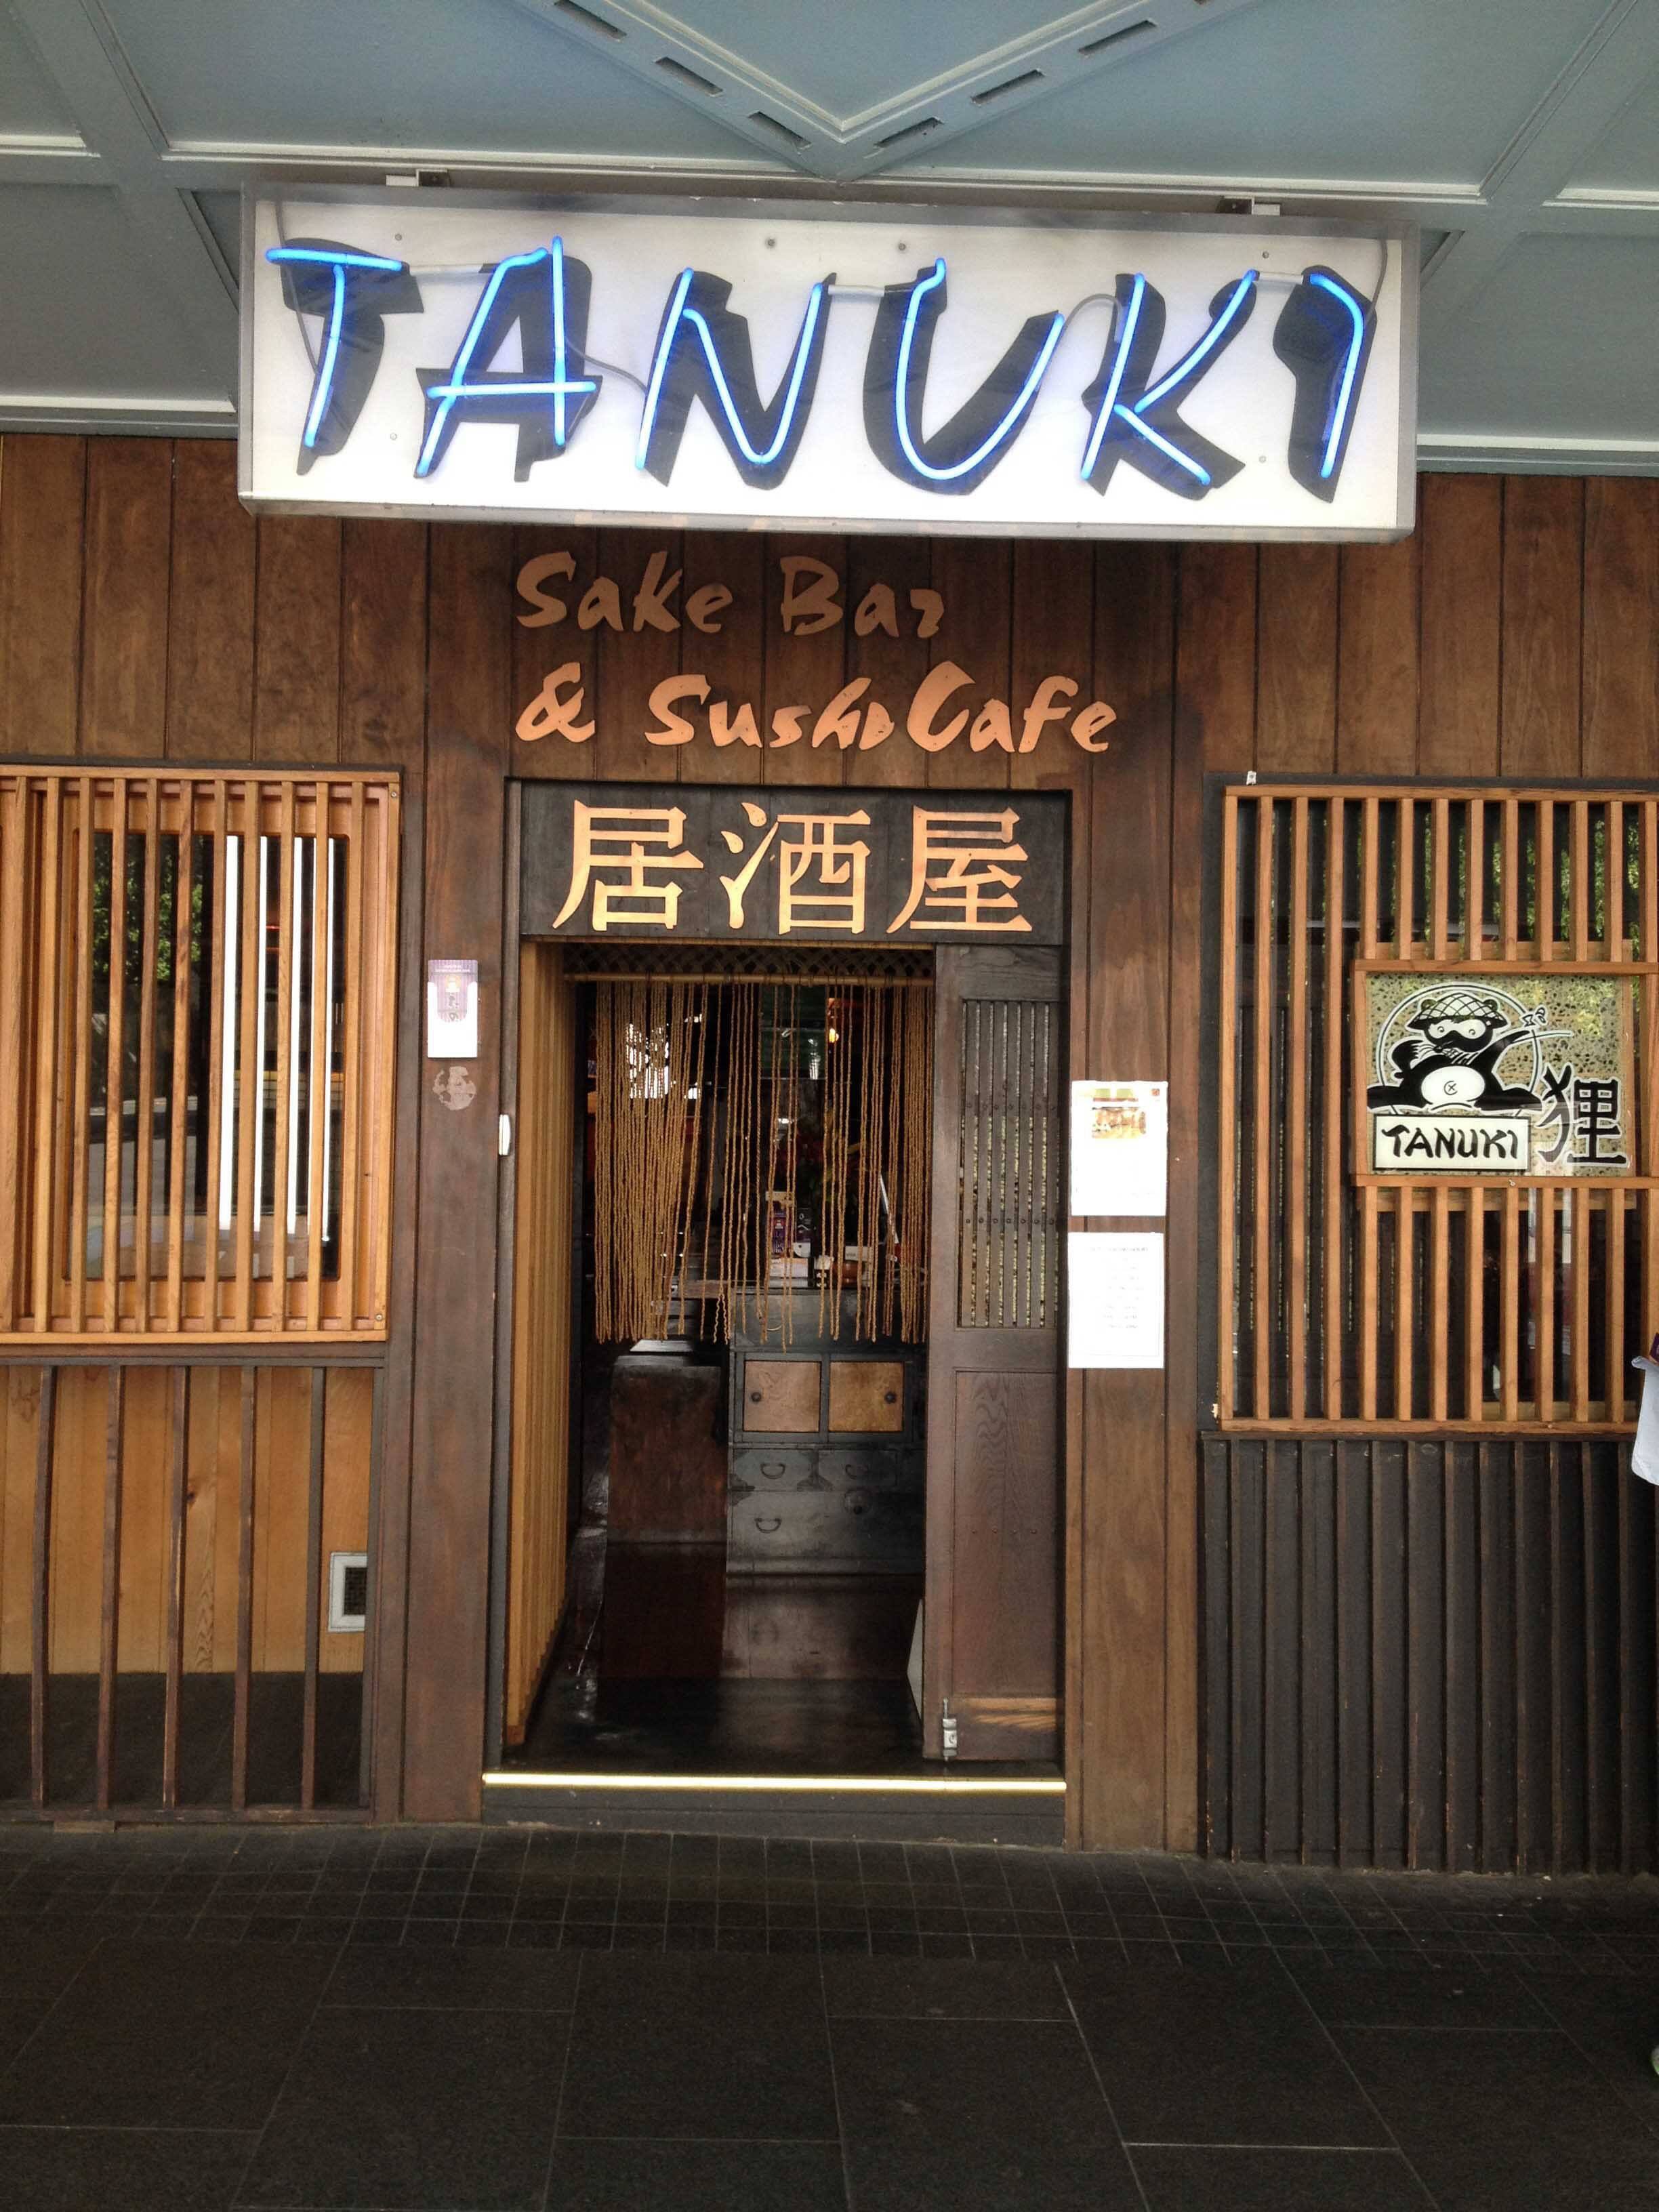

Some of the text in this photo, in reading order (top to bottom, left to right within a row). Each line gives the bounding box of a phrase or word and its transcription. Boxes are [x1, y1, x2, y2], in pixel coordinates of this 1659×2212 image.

[265, 237, 1377, 503] TANUKI
[516, 550, 945, 637] Sake Bar
[515, 661, 596, 743] &
[552, 799, 1033, 935] 居酒屋
[1381, 1124, 1519, 1160] TANUKI
[1537, 1064, 1627, 1164] 狸
